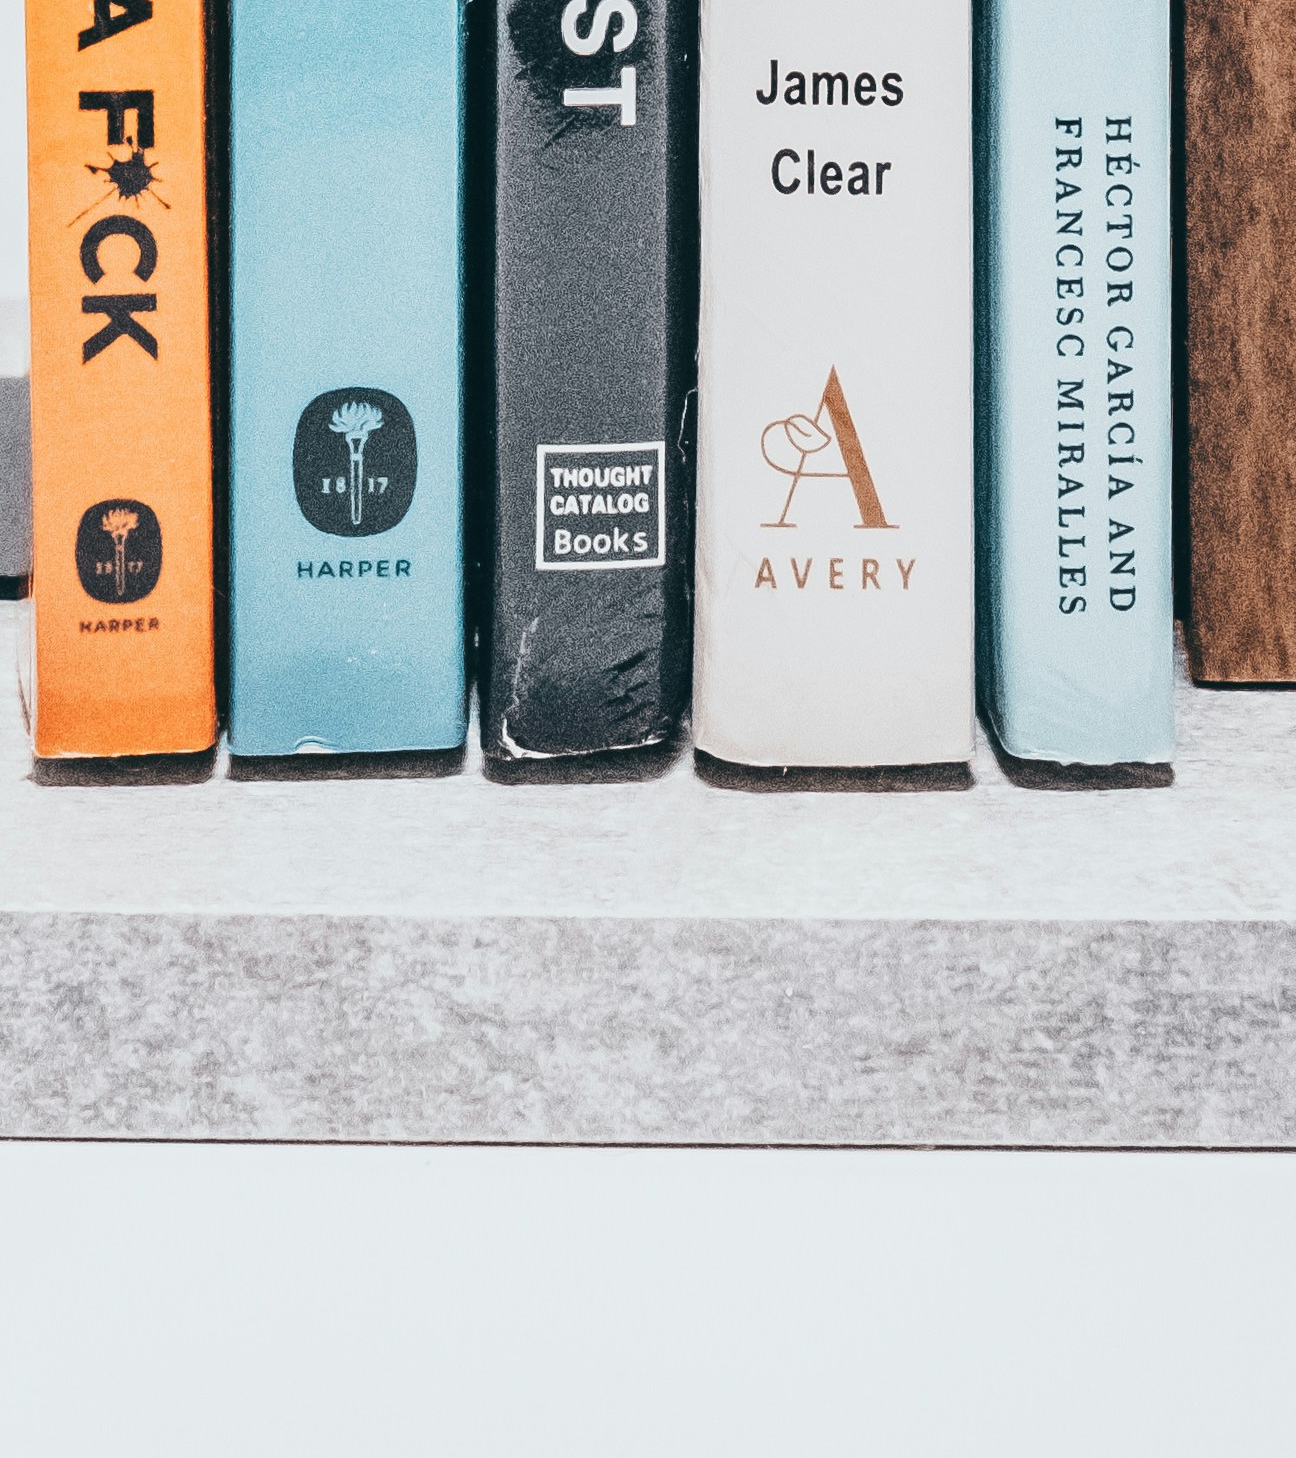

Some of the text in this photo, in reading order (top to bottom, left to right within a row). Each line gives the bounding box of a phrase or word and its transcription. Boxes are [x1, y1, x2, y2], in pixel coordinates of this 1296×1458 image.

[755, 60, 905, 107] James
[770, 148, 892, 196] Clear
[1054, 116, 1088, 616] FRANCESC MIRALLES
[1105, 115, 1144, 614] HÉCTOR GARCÍA AND
[550, 465, 653, 488] THOUGHT
[549, 493, 650, 515] CATALOG
[553, 528, 649, 556] Books
[297, 559, 411, 579] HARPER
[754, 557, 917, 591] AVERY
[79, 617, 160, 633] HARPER
